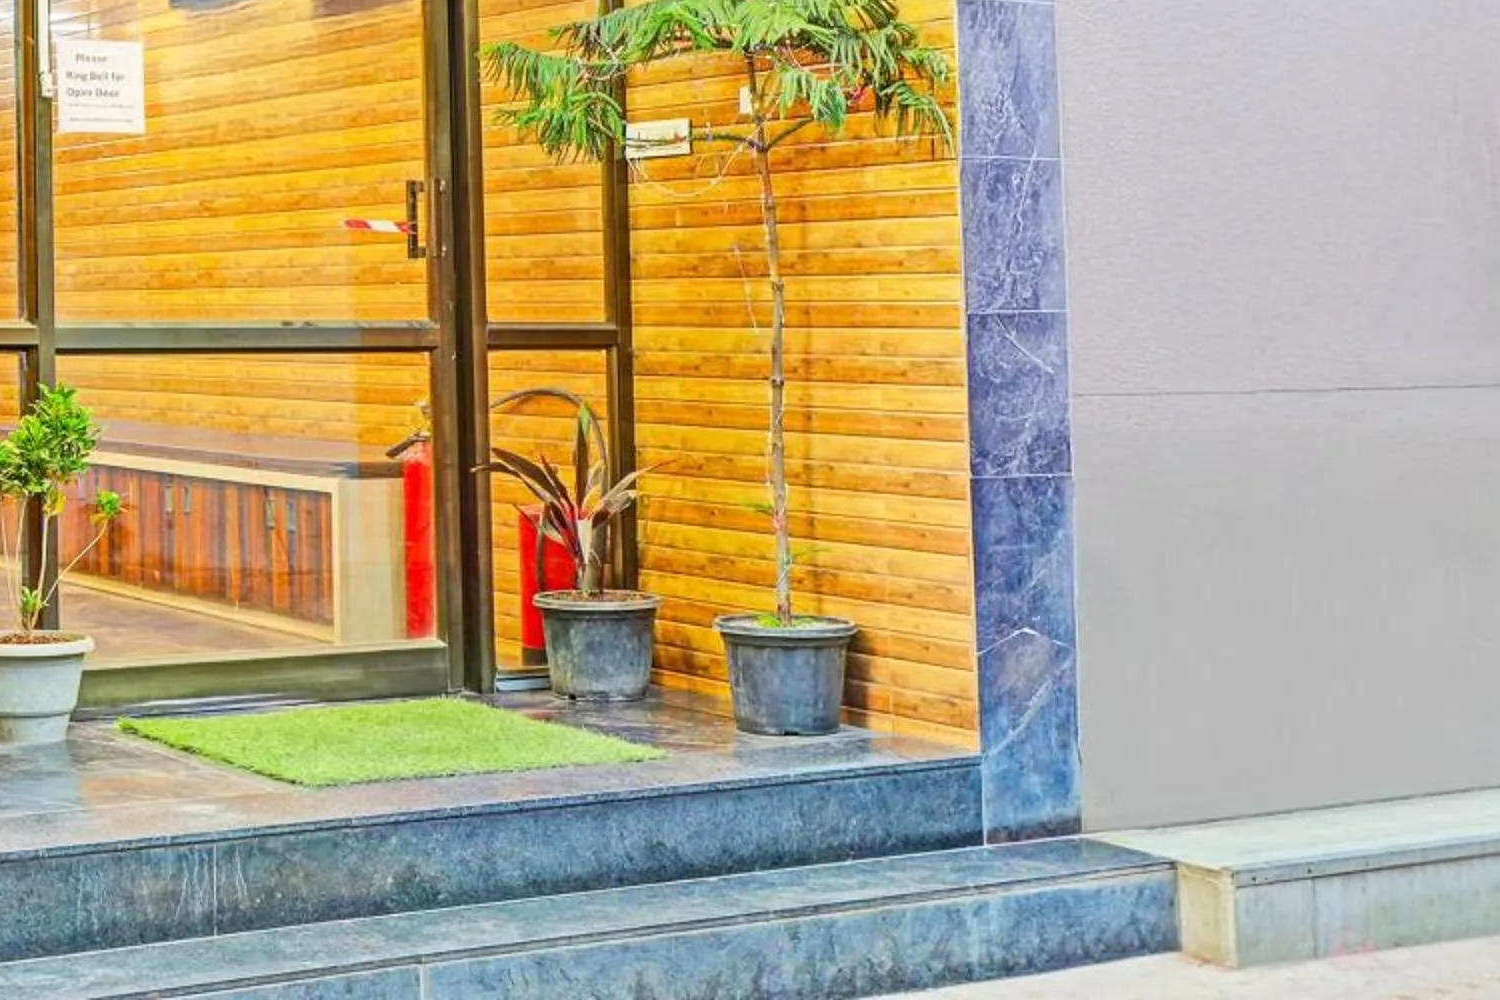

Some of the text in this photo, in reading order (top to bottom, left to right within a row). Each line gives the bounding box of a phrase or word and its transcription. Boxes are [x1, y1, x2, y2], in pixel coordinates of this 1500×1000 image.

[75, 53, 108, 63] Please
[66, 71, 88, 82] Ring
[111, 71, 125, 81] for
[66, 87, 120, 97] Open Door
